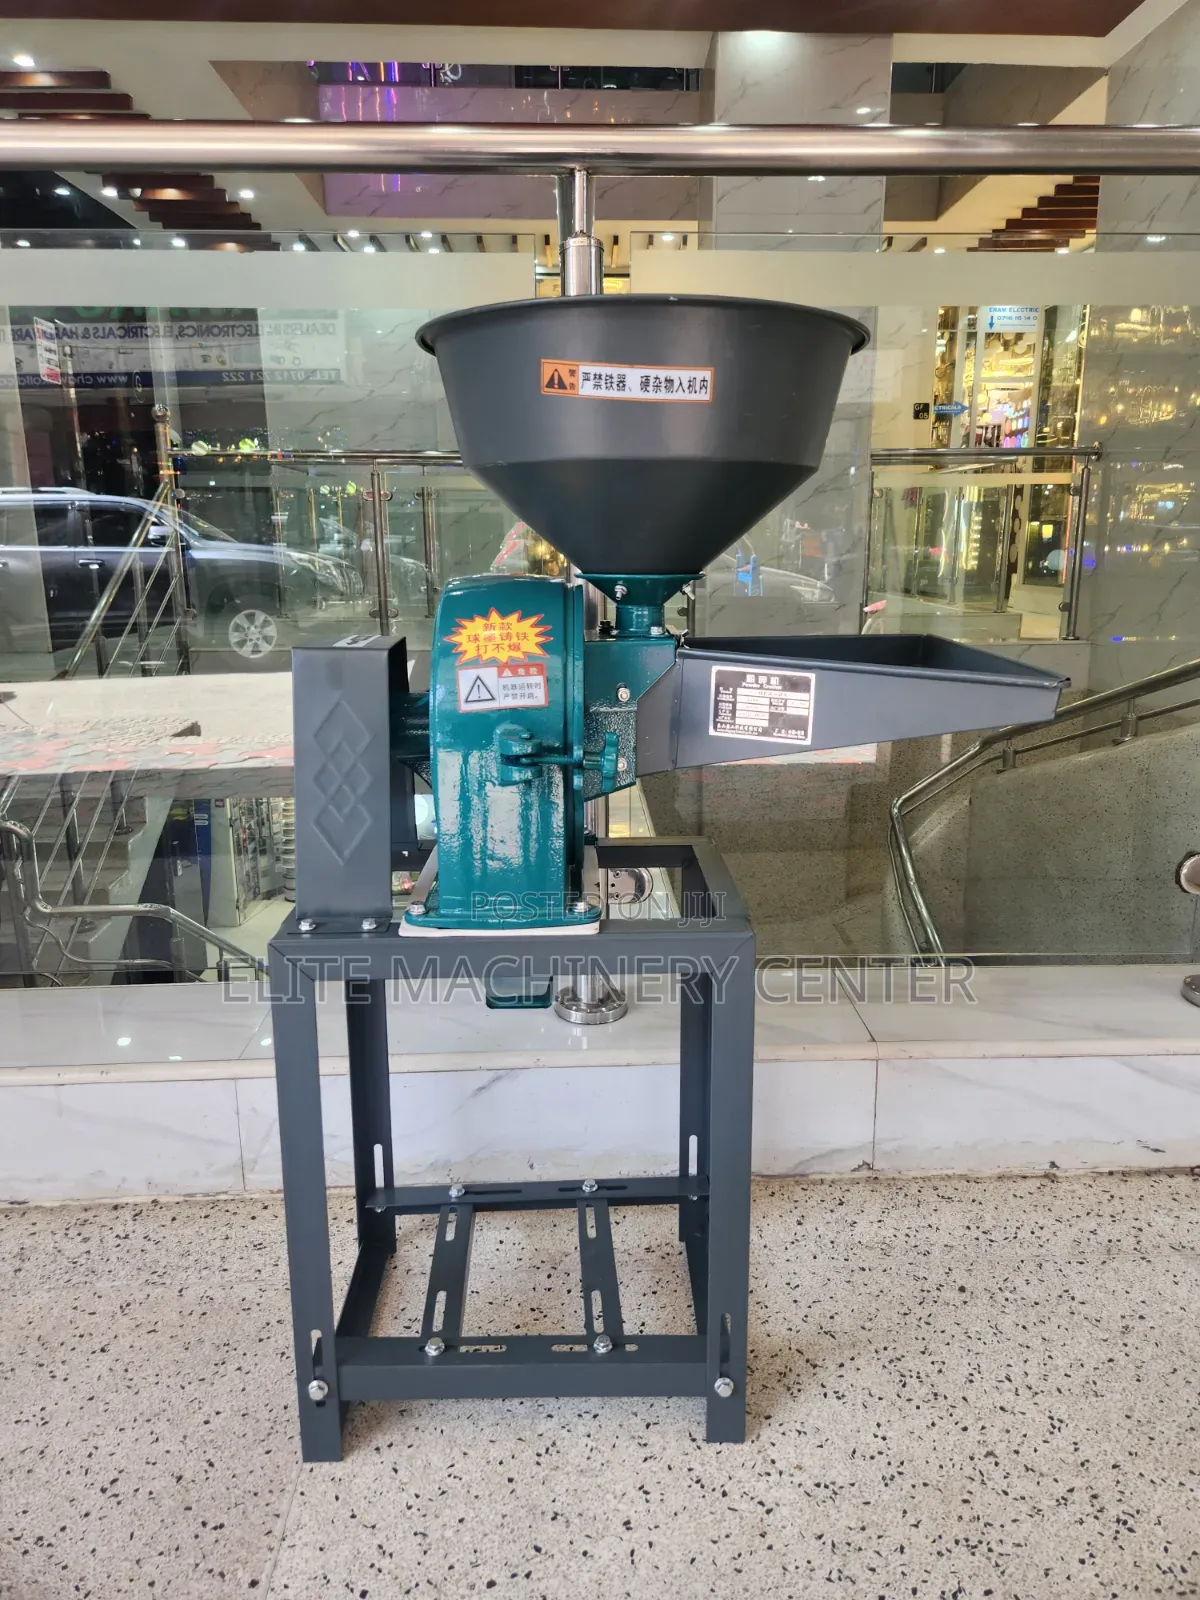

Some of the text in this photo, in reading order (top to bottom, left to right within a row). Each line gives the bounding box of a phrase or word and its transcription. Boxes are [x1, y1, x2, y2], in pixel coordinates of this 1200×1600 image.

[580, 371, 709, 395] 严禁铁器、硬杂物入机内
[482, 622, 512, 631] 新款
[502, 682, 542, 692] 机器运转时
